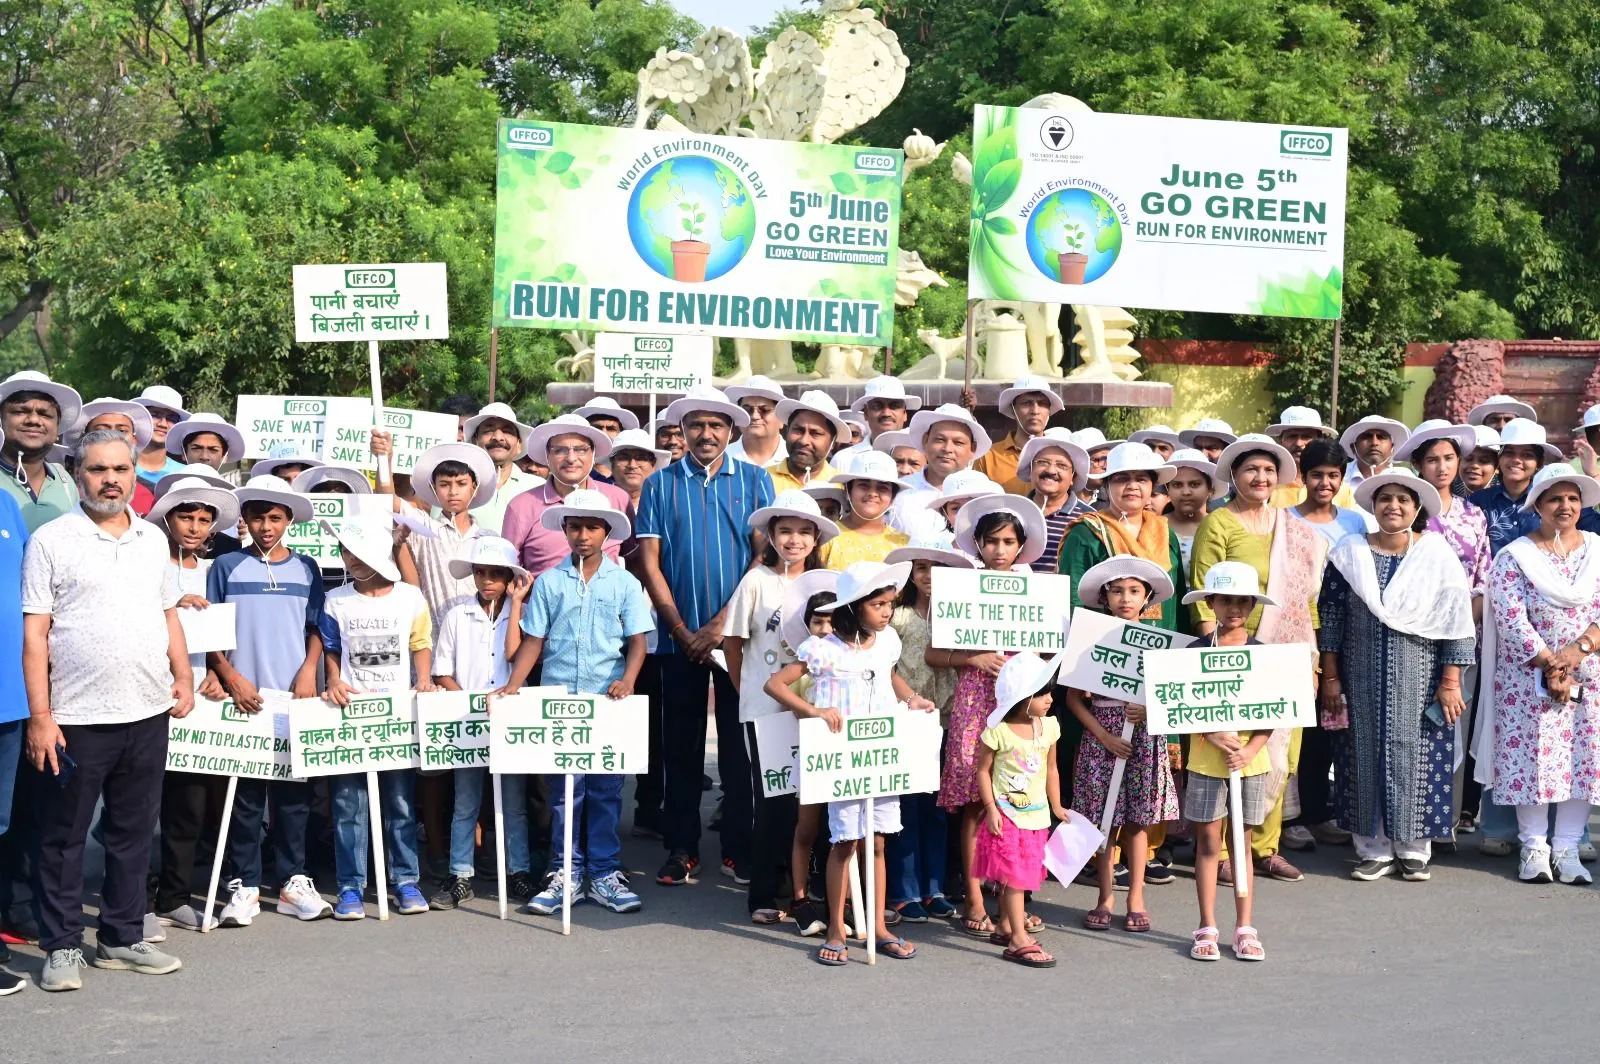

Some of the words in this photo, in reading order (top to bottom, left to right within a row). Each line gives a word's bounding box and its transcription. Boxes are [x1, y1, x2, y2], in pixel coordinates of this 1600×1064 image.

[514, 130, 546, 142] IFFCO
[1288, 136, 1325, 150] IFFCO
[617, 152, 652, 191] World
[653, 138, 750, 172] Environment
[747, 170, 768, 200] Day
[861, 156, 891, 167] IFFCO
[1160, 164, 1244, 190] June
[1256, 168, 1297, 192] 5th
[790, 190, 822, 218] 5th
[828, 194, 888, 223] June
[1018, 187, 1046, 218] World
[1046, 177, 1118, 204] Environment
[1116, 203, 1131, 226] Day
[1140, 192, 1192, 216] GO
[1205, 195, 1326, 224] GREEN
[766, 222, 800, 241] GO
[808, 224, 888, 247] GREEN
[1136, 221, 1170, 237] RUN
[1176, 224, 1206, 239] FOR
[1212, 226, 1327, 246] ENVIRONMENT
[769, 246, 794, 258] Love
[796, 248, 820, 260] Your
[822, 250, 885, 264] Environment
[352, 273, 386, 284] IFFCO
[310, 290, 346, 310] पानी
[353, 289, 400, 310] बचाएं
[514, 283, 580, 319] RUN
[589, 288, 649, 322] FOR
[658, 291, 879, 335] ENVIRONMENT
[310, 312, 365, 334] बिजली
[640, 340, 668, 350] IFFCO
[602, 354, 632, 370] पानी
[610, 372, 654, 390] बिजली
[289, 402, 320, 412] IFFCO
[252, 420, 283, 433] SAVE
[336, 428, 367, 443] SAVE
[331, 447, 362, 463] SAVE
[987, 578, 1020, 591] IFFCO
[937, 602, 972, 620] SAVE
[979, 604, 1004, 621] THE
[1009, 605, 1044, 622] TREE
[954, 628, 988, 646] SAVE
[992, 630, 1017, 647] THE
[1020, 631, 1065, 648] EARTH
[1128, 630, 1163, 649] IFFCO
[1091, 644, 1131, 669] जल
[1208, 654, 1244, 668] IFFCO
[1102, 670, 1143, 696] कल
[1154, 682, 1185, 705] वृक्ष
[348, 702, 385, 716] IFFCO
[549, 703, 586, 715] IFFCO
[1167, 700, 1235, 728] हरियाली
[170, 727, 190, 744] SAY
[191, 729, 206, 745] NO
[209, 732, 221, 747] TO
[224, 732, 271, 750] PLASTIC
[300, 728, 336, 746] वाहन
[338, 722, 357, 742] की
[505, 726, 547, 745] जल
[552, 720, 567, 746] है
[572, 720, 593, 745] तो
[854, 721, 887, 737] IFFCO
[168, 752, 188, 767] YES
[192, 755, 205, 769] TO
[302, 745, 365, 767] नियमित
[424, 744, 477, 766] निश्चित
[554, 751, 596, 771] कल
[806, 752, 843, 772] SAVE
[851, 748, 899, 769] WATER
[832, 777, 871, 797] SAVE
[879, 773, 910, 793] LIFE
